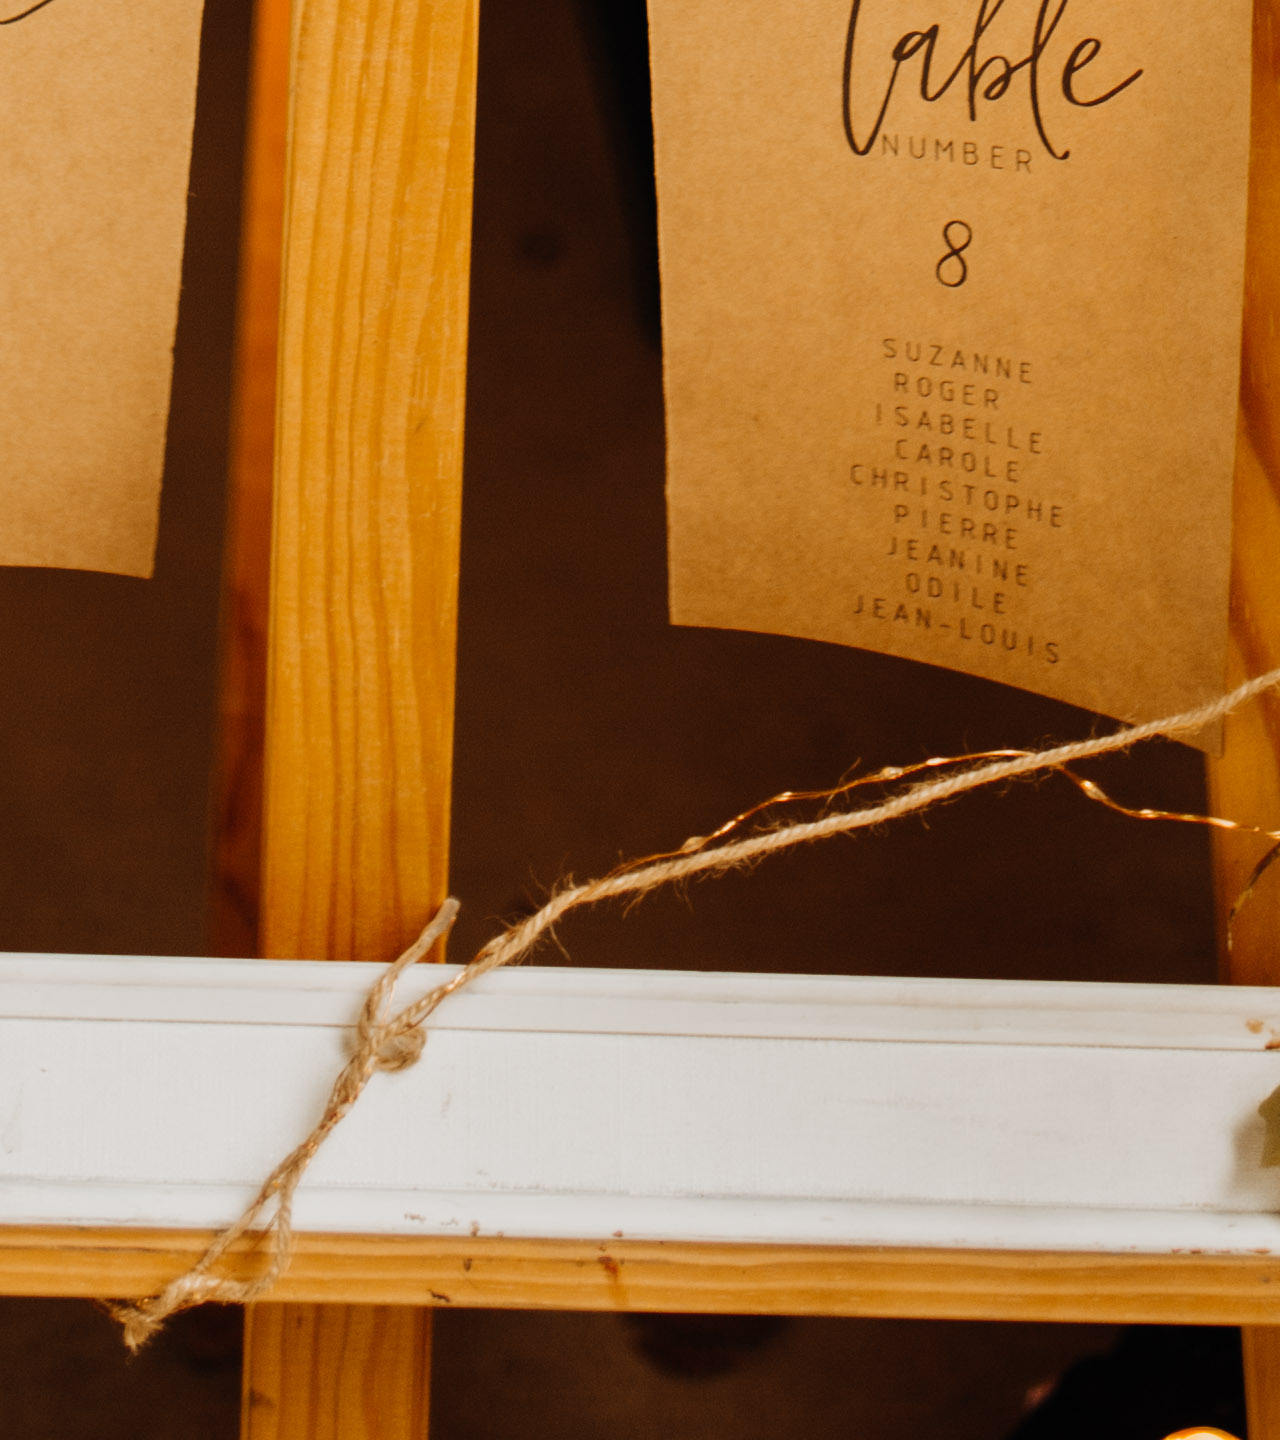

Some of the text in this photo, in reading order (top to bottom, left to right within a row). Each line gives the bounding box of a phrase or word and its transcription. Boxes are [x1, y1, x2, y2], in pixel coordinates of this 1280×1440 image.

[880, 133, 1033, 174] NUMBER
[935, 220, 973, 289] 8
[882, 337, 1032, 384] SUZANNE
[893, 371, 999, 409] ROGER
[876, 403, 1041, 454] ISABELLE
[895, 439, 1019, 483] CAROLE
[850, 463, 1062, 528] CHRISTOPHE
[893, 504, 1017, 550] PIERRE
[888, 536, 1029, 587] JEANINE
[905, 572, 1005, 614] ODILE
[853, 595, 1059, 664] JEAN-LOUIS
